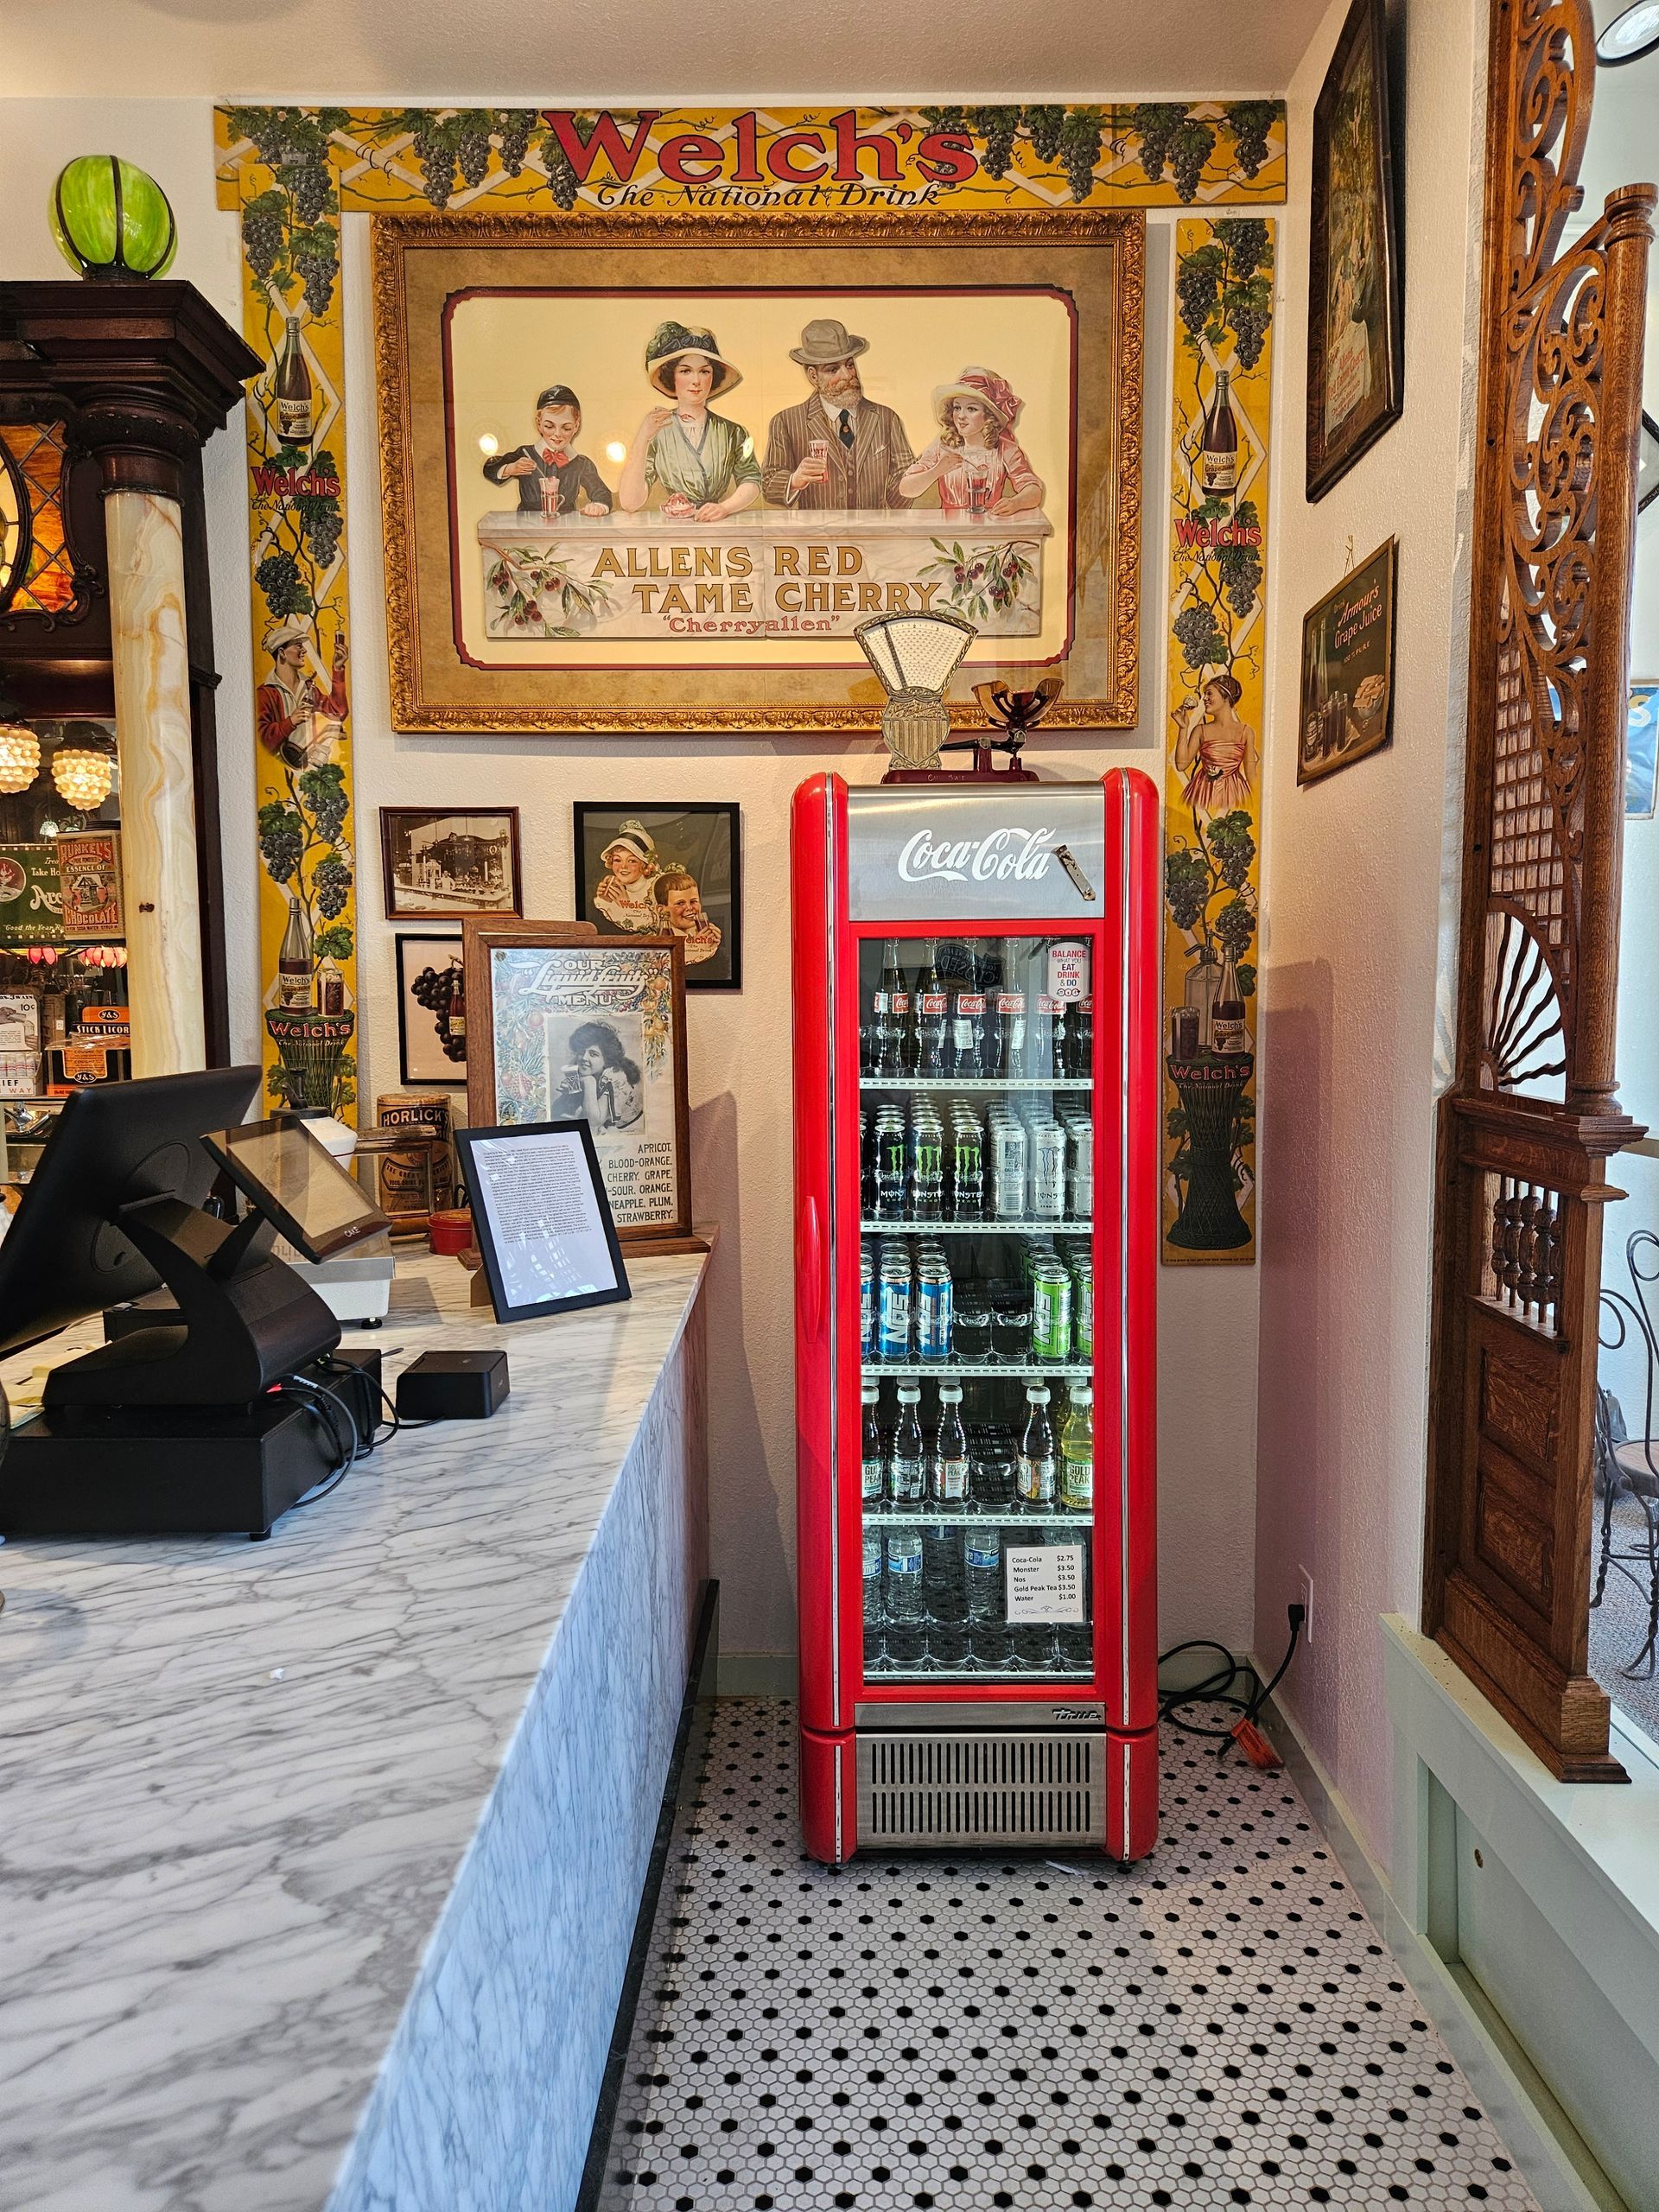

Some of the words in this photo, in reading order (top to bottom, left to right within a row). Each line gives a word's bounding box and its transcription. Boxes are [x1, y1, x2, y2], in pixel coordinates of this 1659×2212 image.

[541, 109, 978, 183] Welch's
[597, 182, 654, 207] The
[667, 183, 826, 207] National
[836, 183, 941, 207] Drink
[280, 401, 309, 412] Welch's
[1206, 454, 1235, 465] Welch's
[250, 466, 341, 497] Welch's
[1173, 518, 1262, 548] Welch's
[590, 546, 753, 578] ALLENS
[772, 545, 864, 576] RED
[632, 583, 753, 613] TAME
[774, 582, 940, 612] CHERRY
[1338, 578, 1380, 627] Armour's
[663, 614, 840, 635] "Cherryallen"
[1334, 622, 1358, 649] Grape
[1359, 604, 1382, 630] Juice
[898, 827, 1057, 882] Coca-Cola
[31, 868, 48, 876] Take
[64, 902, 118, 925] CHOCOLATE
[1052, 950, 1086, 958] BALANCE
[563, 960, 606, 970] OUR
[283, 976, 310, 985] Welch's
[558, 995, 612, 1006] MENU
[269, 1020, 351, 1037] Welch's
[1216, 1021, 1243, 1030] Welch's
[1170, 1064, 1250, 1080] Welch's
[383, 1109, 448, 1127] HORLICK'S
[1070, 1465, 1090, 1475] GOLD
[1070, 1474, 1090, 1484] PEAK
